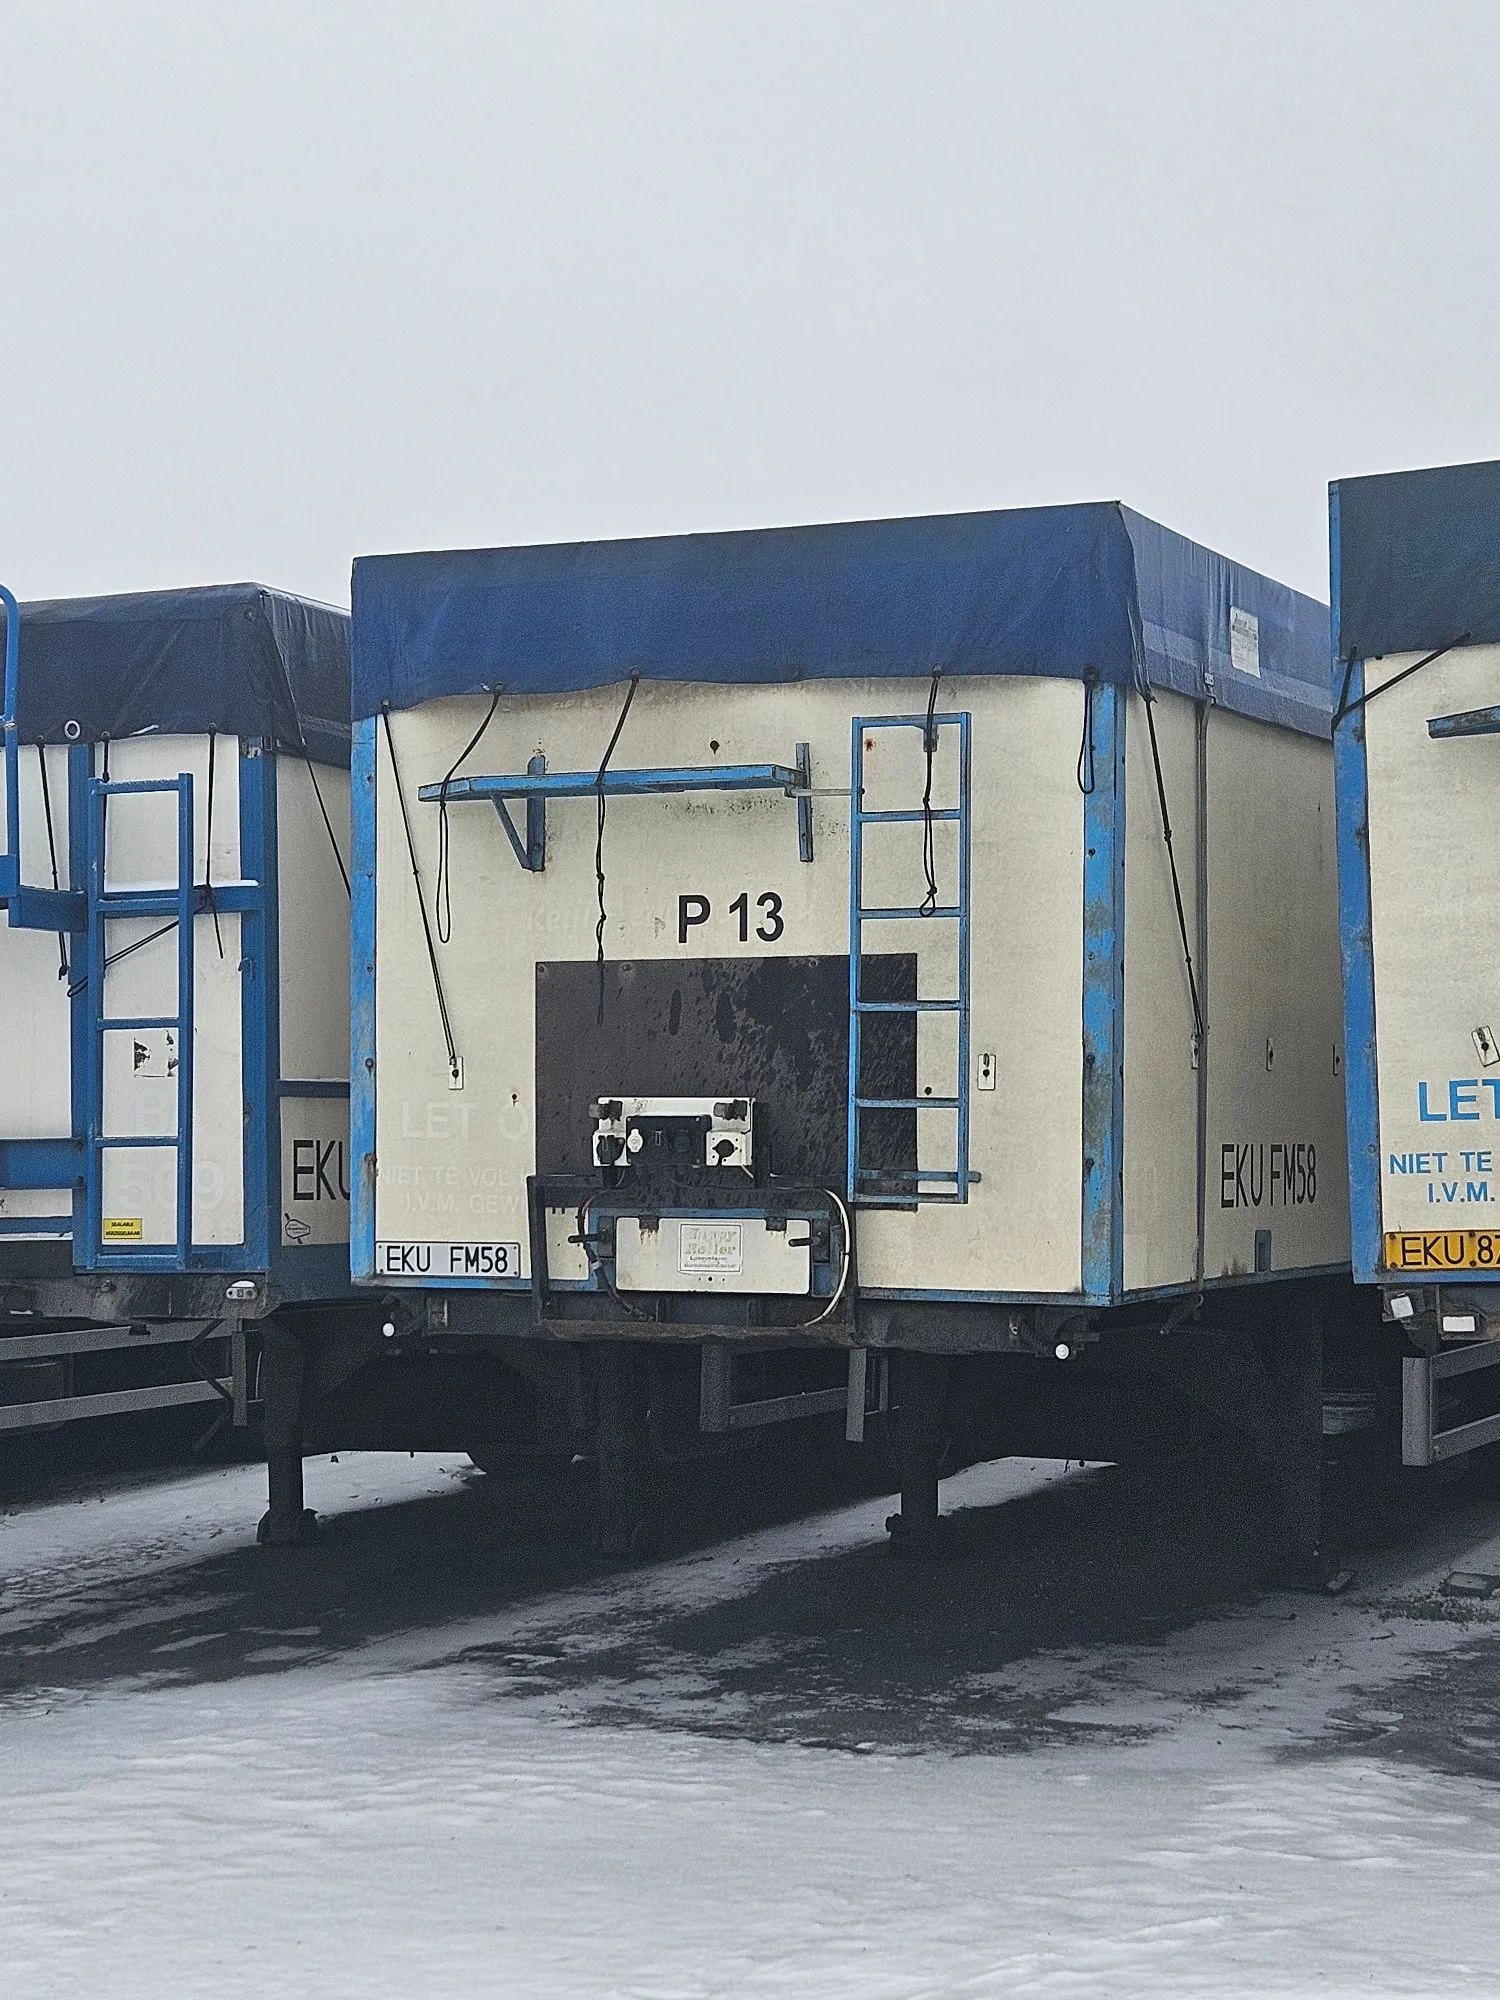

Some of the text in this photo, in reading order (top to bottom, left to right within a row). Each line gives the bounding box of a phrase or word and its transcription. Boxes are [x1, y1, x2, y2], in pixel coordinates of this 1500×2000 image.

[678, 894, 711, 944] P
[728, 891, 784, 943] 13
[1221, 1143, 1317, 1208] EKU FM58
[1389, 1150, 1493, 1175] NIET TE
[1427, 1181, 1496, 1203] I.V.M.
[387, 1245, 508, 1274] EKU FM58
[1401, 1235, 1465, 1266] EKU
